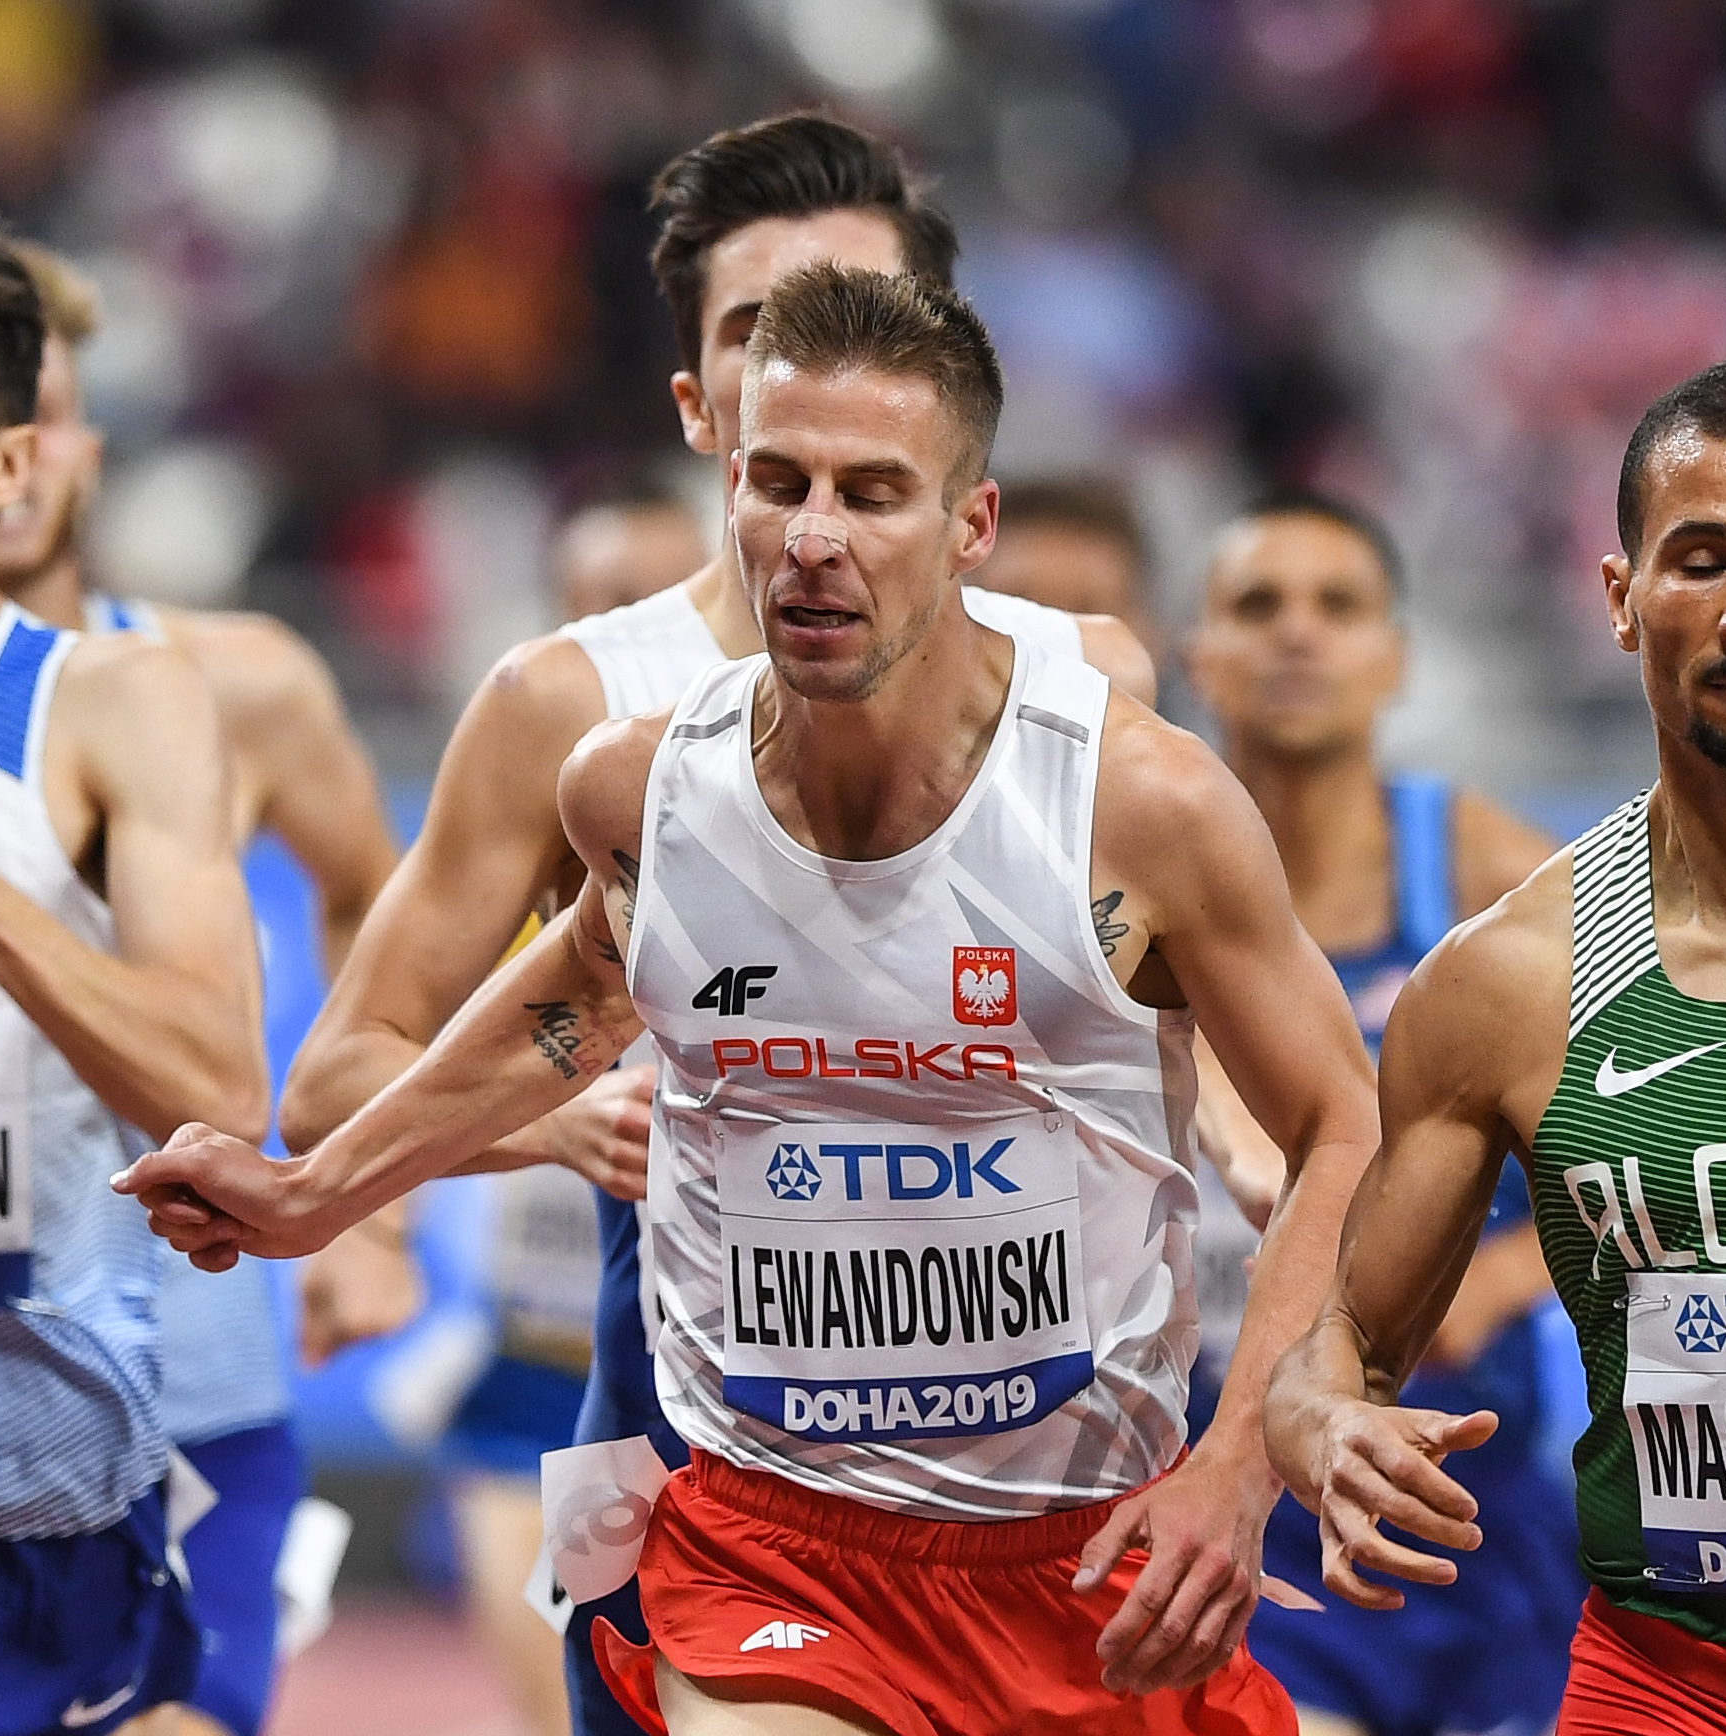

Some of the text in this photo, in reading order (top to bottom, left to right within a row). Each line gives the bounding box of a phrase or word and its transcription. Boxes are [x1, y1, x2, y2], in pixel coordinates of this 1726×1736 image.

[957, 949, 1011, 962] POLSKA
[712, 1037, 1017, 1082] POLSKA
[819, 1137, 1022, 1201] TDK
[730, 1229, 1070, 1349] LEWANDOWSKI
[783, 1374, 1037, 1434] DOHA2019
